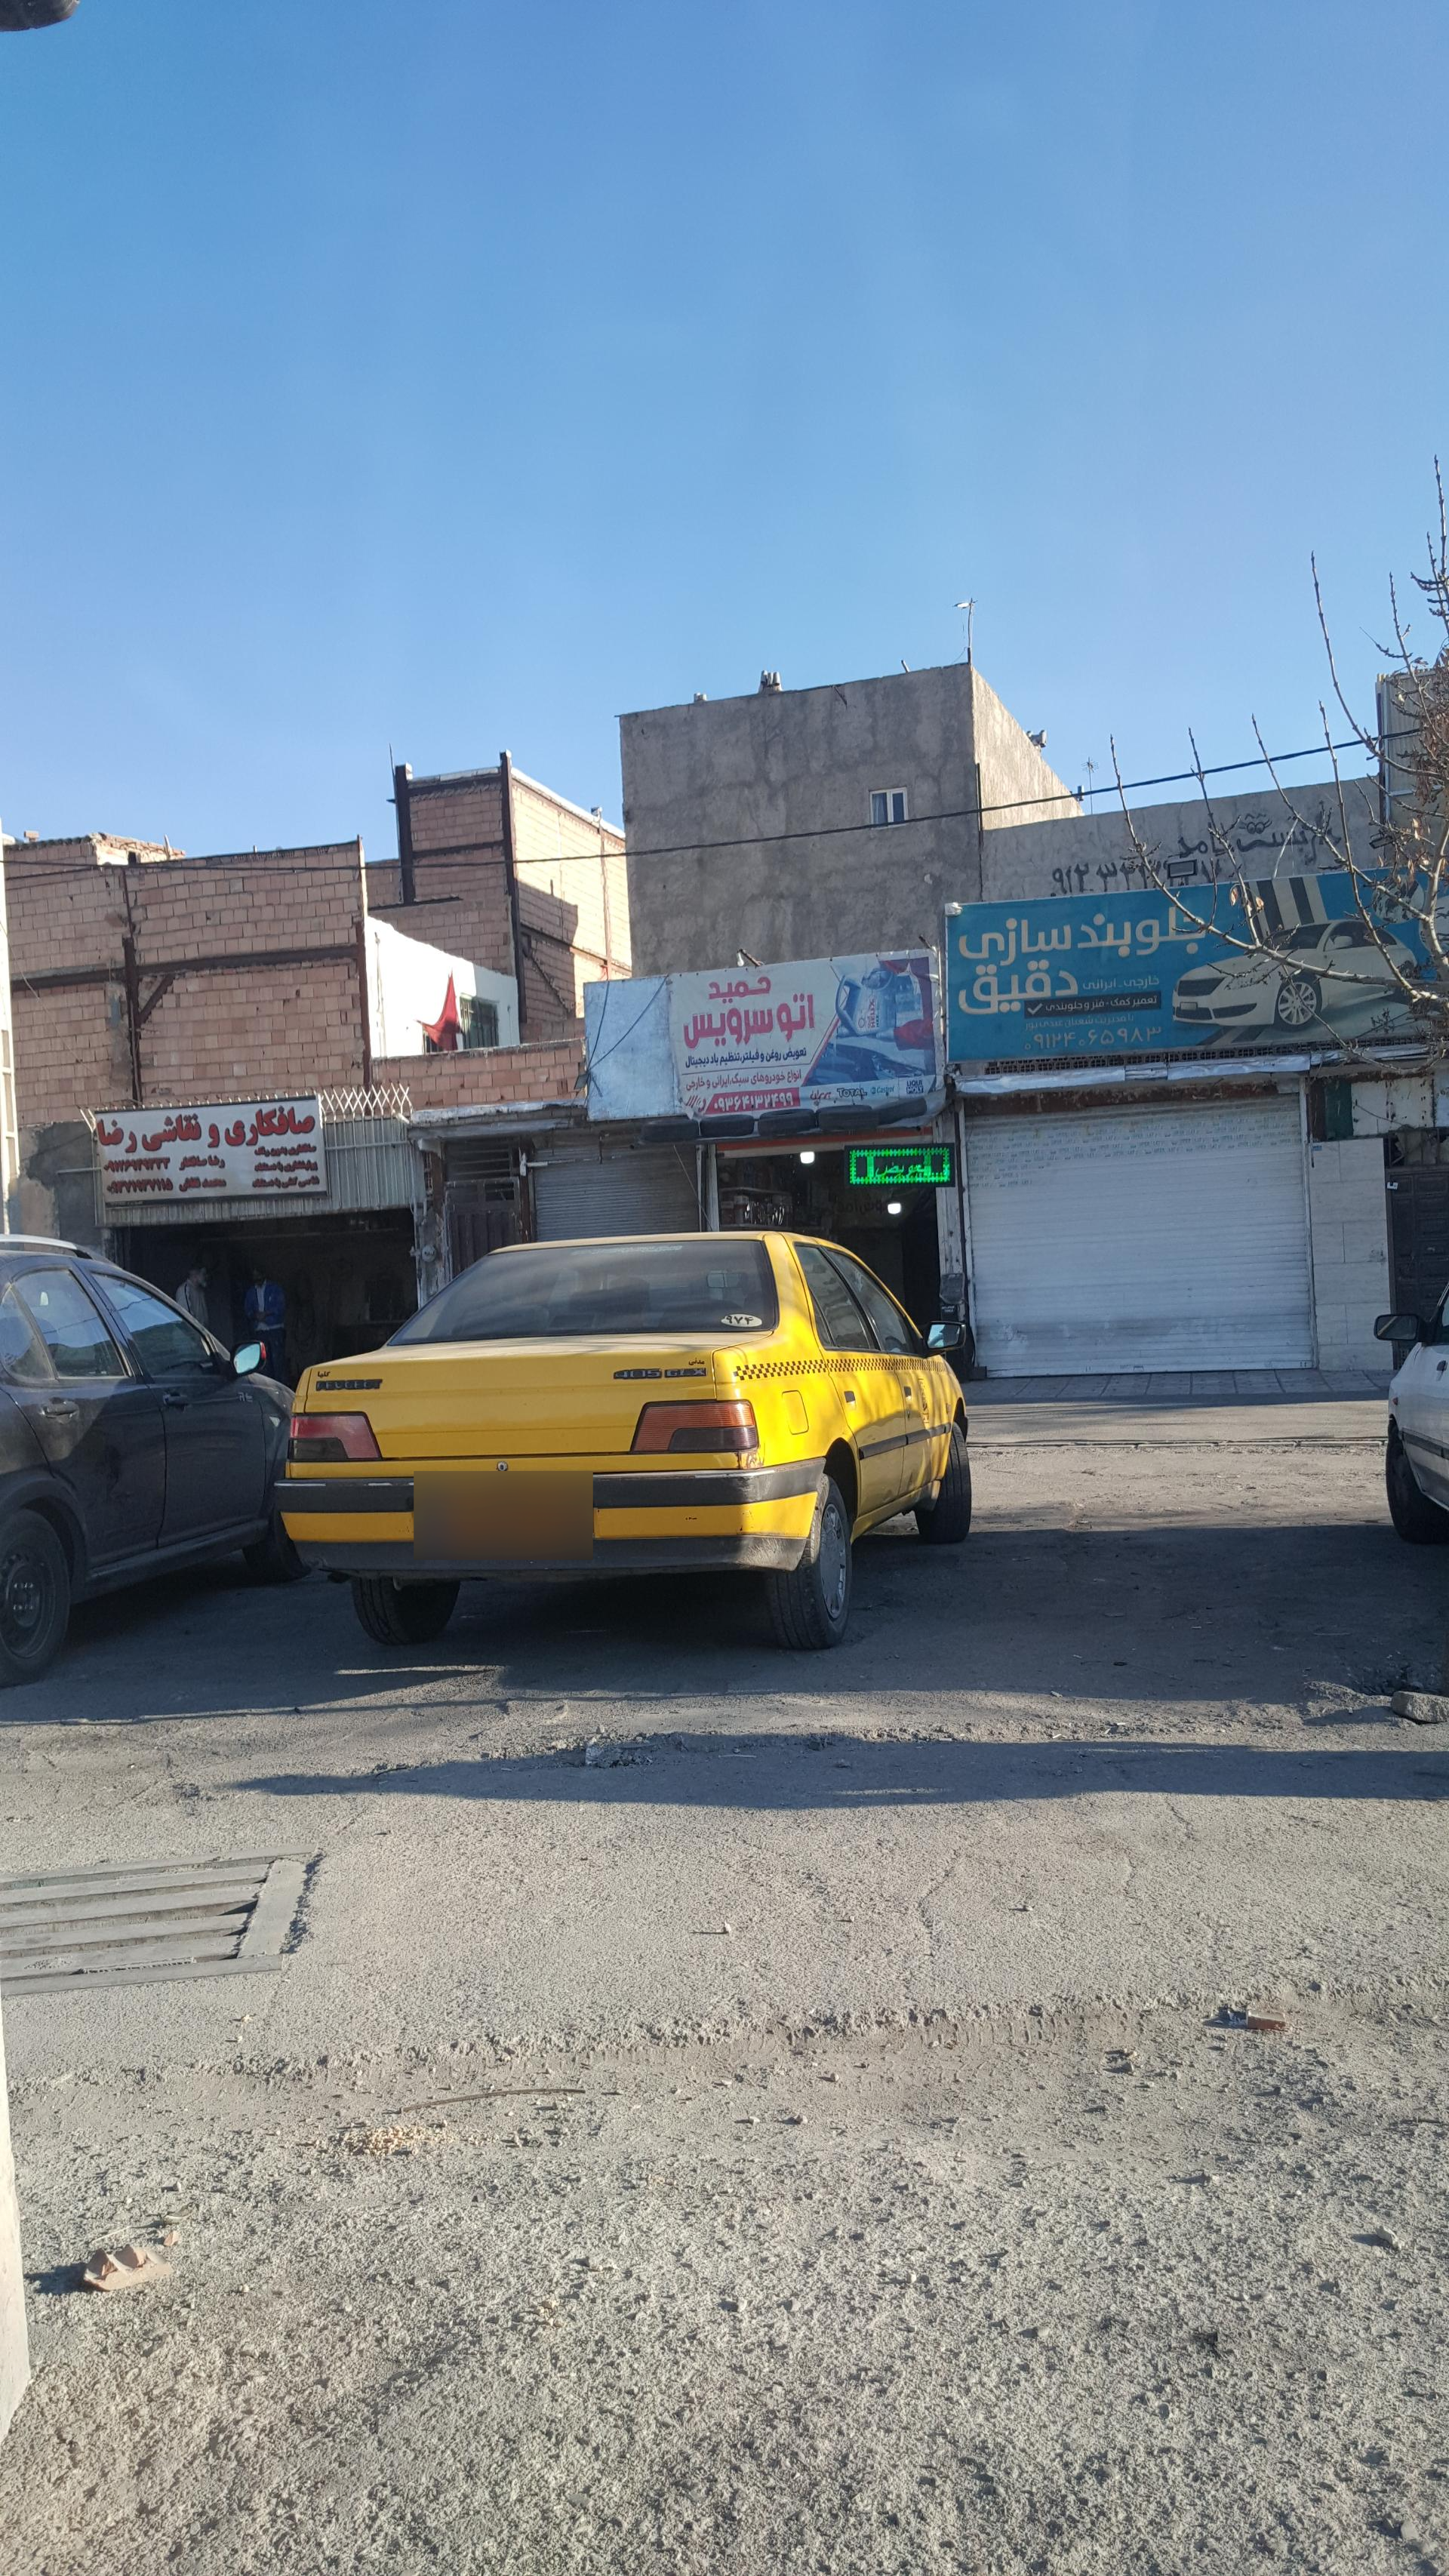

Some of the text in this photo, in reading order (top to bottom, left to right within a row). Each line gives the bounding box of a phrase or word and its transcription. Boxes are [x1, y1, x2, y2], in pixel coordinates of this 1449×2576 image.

[958, 959, 1078, 1015] دقیق
[1082, 974, 1160, 991] خارجی ایرانی
[708, 976, 771, 1004] حمید
[1045, 1000, 1083, 1012] جلوبندی
[1092, 999, 1105, 1010] فنر
[1110, 997, 1132, 1007] کمک
[1133, 996, 1157, 1007] تعمیر
[683, 993, 815, 1049] اتو سرویس
[1024, 1026, 1162, 1051] ۰۹۱۲۴۰۶۵۹۸۳
[760, 1052, 764, 1063] و
[765, 1048, 782, 1062] روغن
[782, 1047, 807, 1060] تعویض
[685, 1053, 709, 1069] دیجیتال
[686, 1076, 705, 1091] خارجی
[750, 1069, 786, 1085] خودروهای
[786, 1069, 801, 1084] انواع
[706, 1079, 711, 1089] و
[906, 1086, 924, 1094] MOLY
[836, 1086, 868, 1098] TOTAL
[97, 1105, 315, 1153] صافکاری و نقاشی رضا
[614, 1368, 662, 1380] 405
